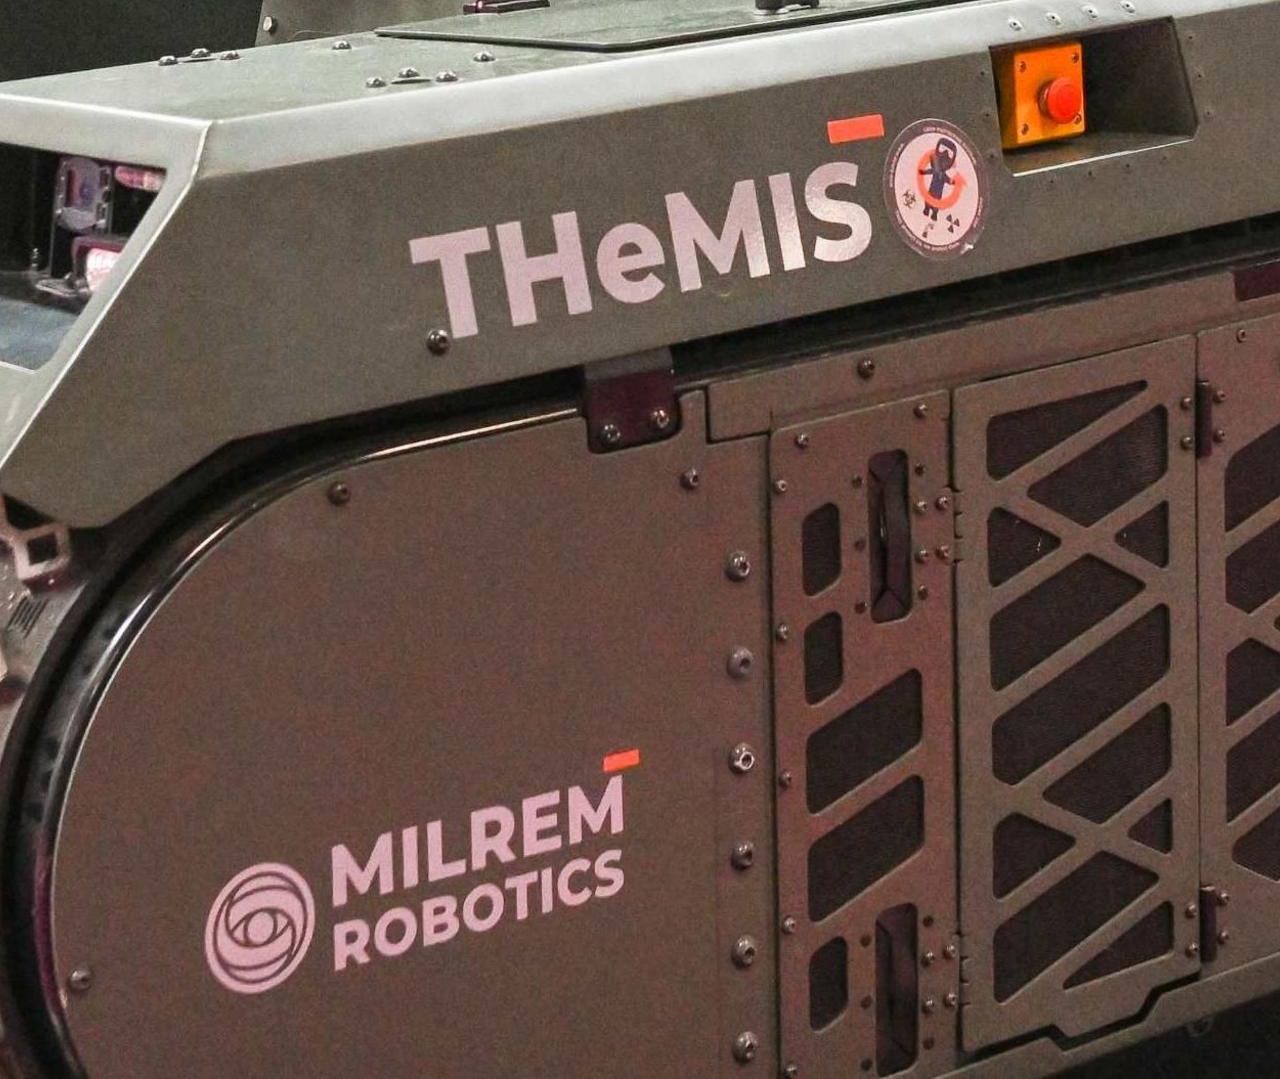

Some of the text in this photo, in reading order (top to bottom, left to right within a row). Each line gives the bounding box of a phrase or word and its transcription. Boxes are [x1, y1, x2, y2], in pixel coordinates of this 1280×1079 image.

[409, 161, 873, 339] THeMIS
[331, 775, 623, 907] MILREM
[332, 850, 624, 971] ROBOTICS
